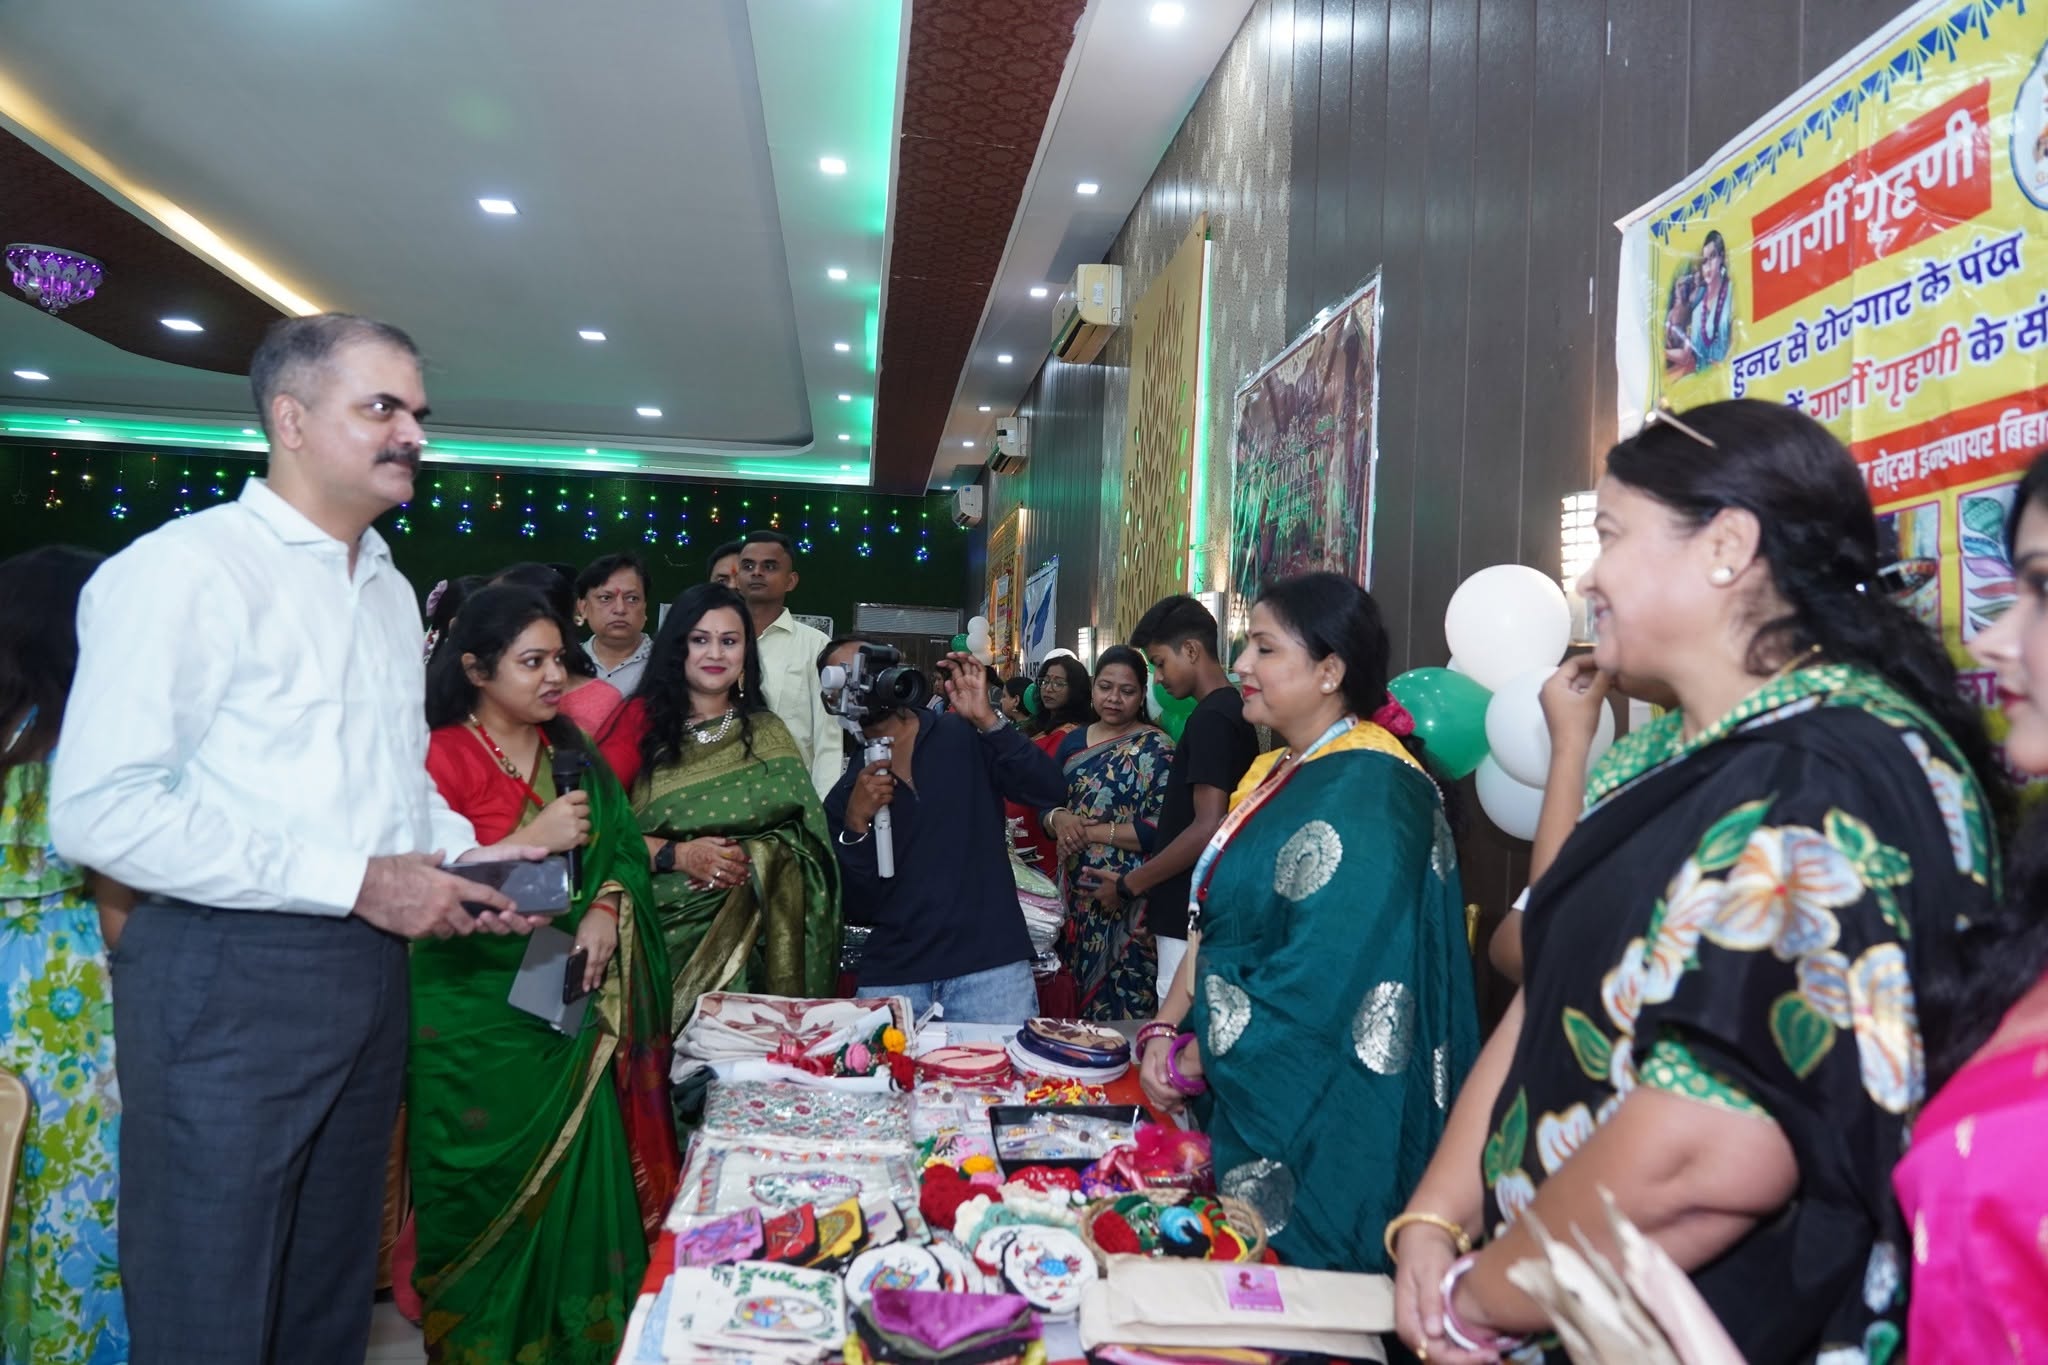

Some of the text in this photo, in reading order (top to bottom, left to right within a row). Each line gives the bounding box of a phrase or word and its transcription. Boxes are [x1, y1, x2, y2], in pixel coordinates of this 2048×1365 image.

[1759, 176, 1854, 273] गार्गी
[1733, 341, 1782, 398] हुनर
[1787, 322, 1808, 363] से
[1918, 262, 1951, 302] के
[1958, 232, 2023, 284] पंख
[1875, 327, 1961, 407] गृहणी
[1968, 318, 2007, 361] के
[2017, 294, 2048, 348] सं
[1996, 408, 2048, 453] बिहा
